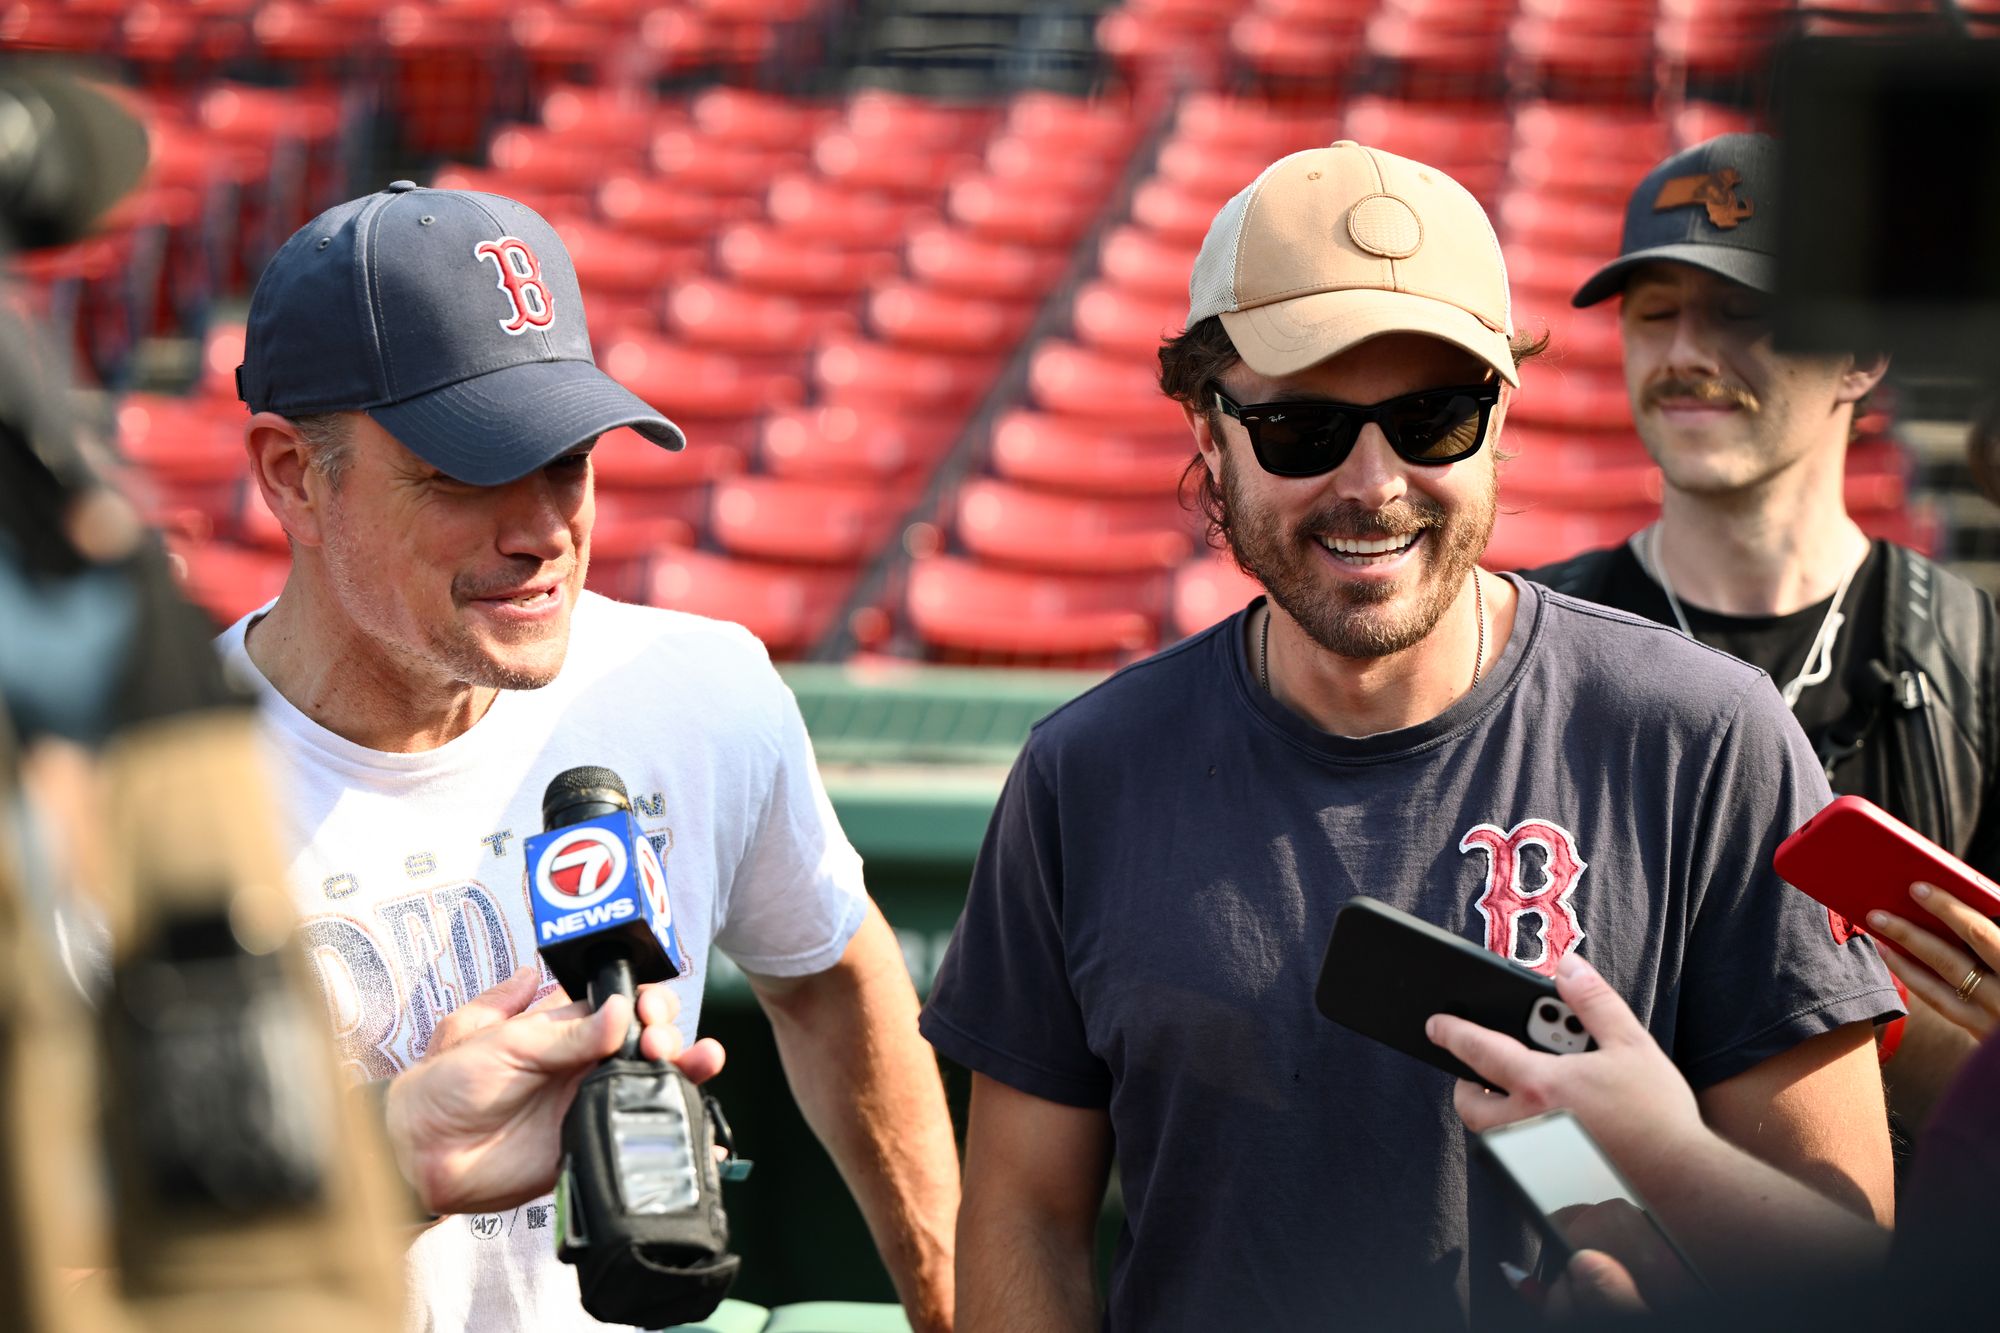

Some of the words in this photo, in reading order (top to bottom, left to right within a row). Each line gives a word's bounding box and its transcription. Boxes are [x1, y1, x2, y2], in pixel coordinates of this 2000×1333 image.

[474, 236, 555, 335] B
[549, 840, 615, 897] 7
[1459, 818, 1588, 980] B
[541, 898, 635, 939] NEWS
